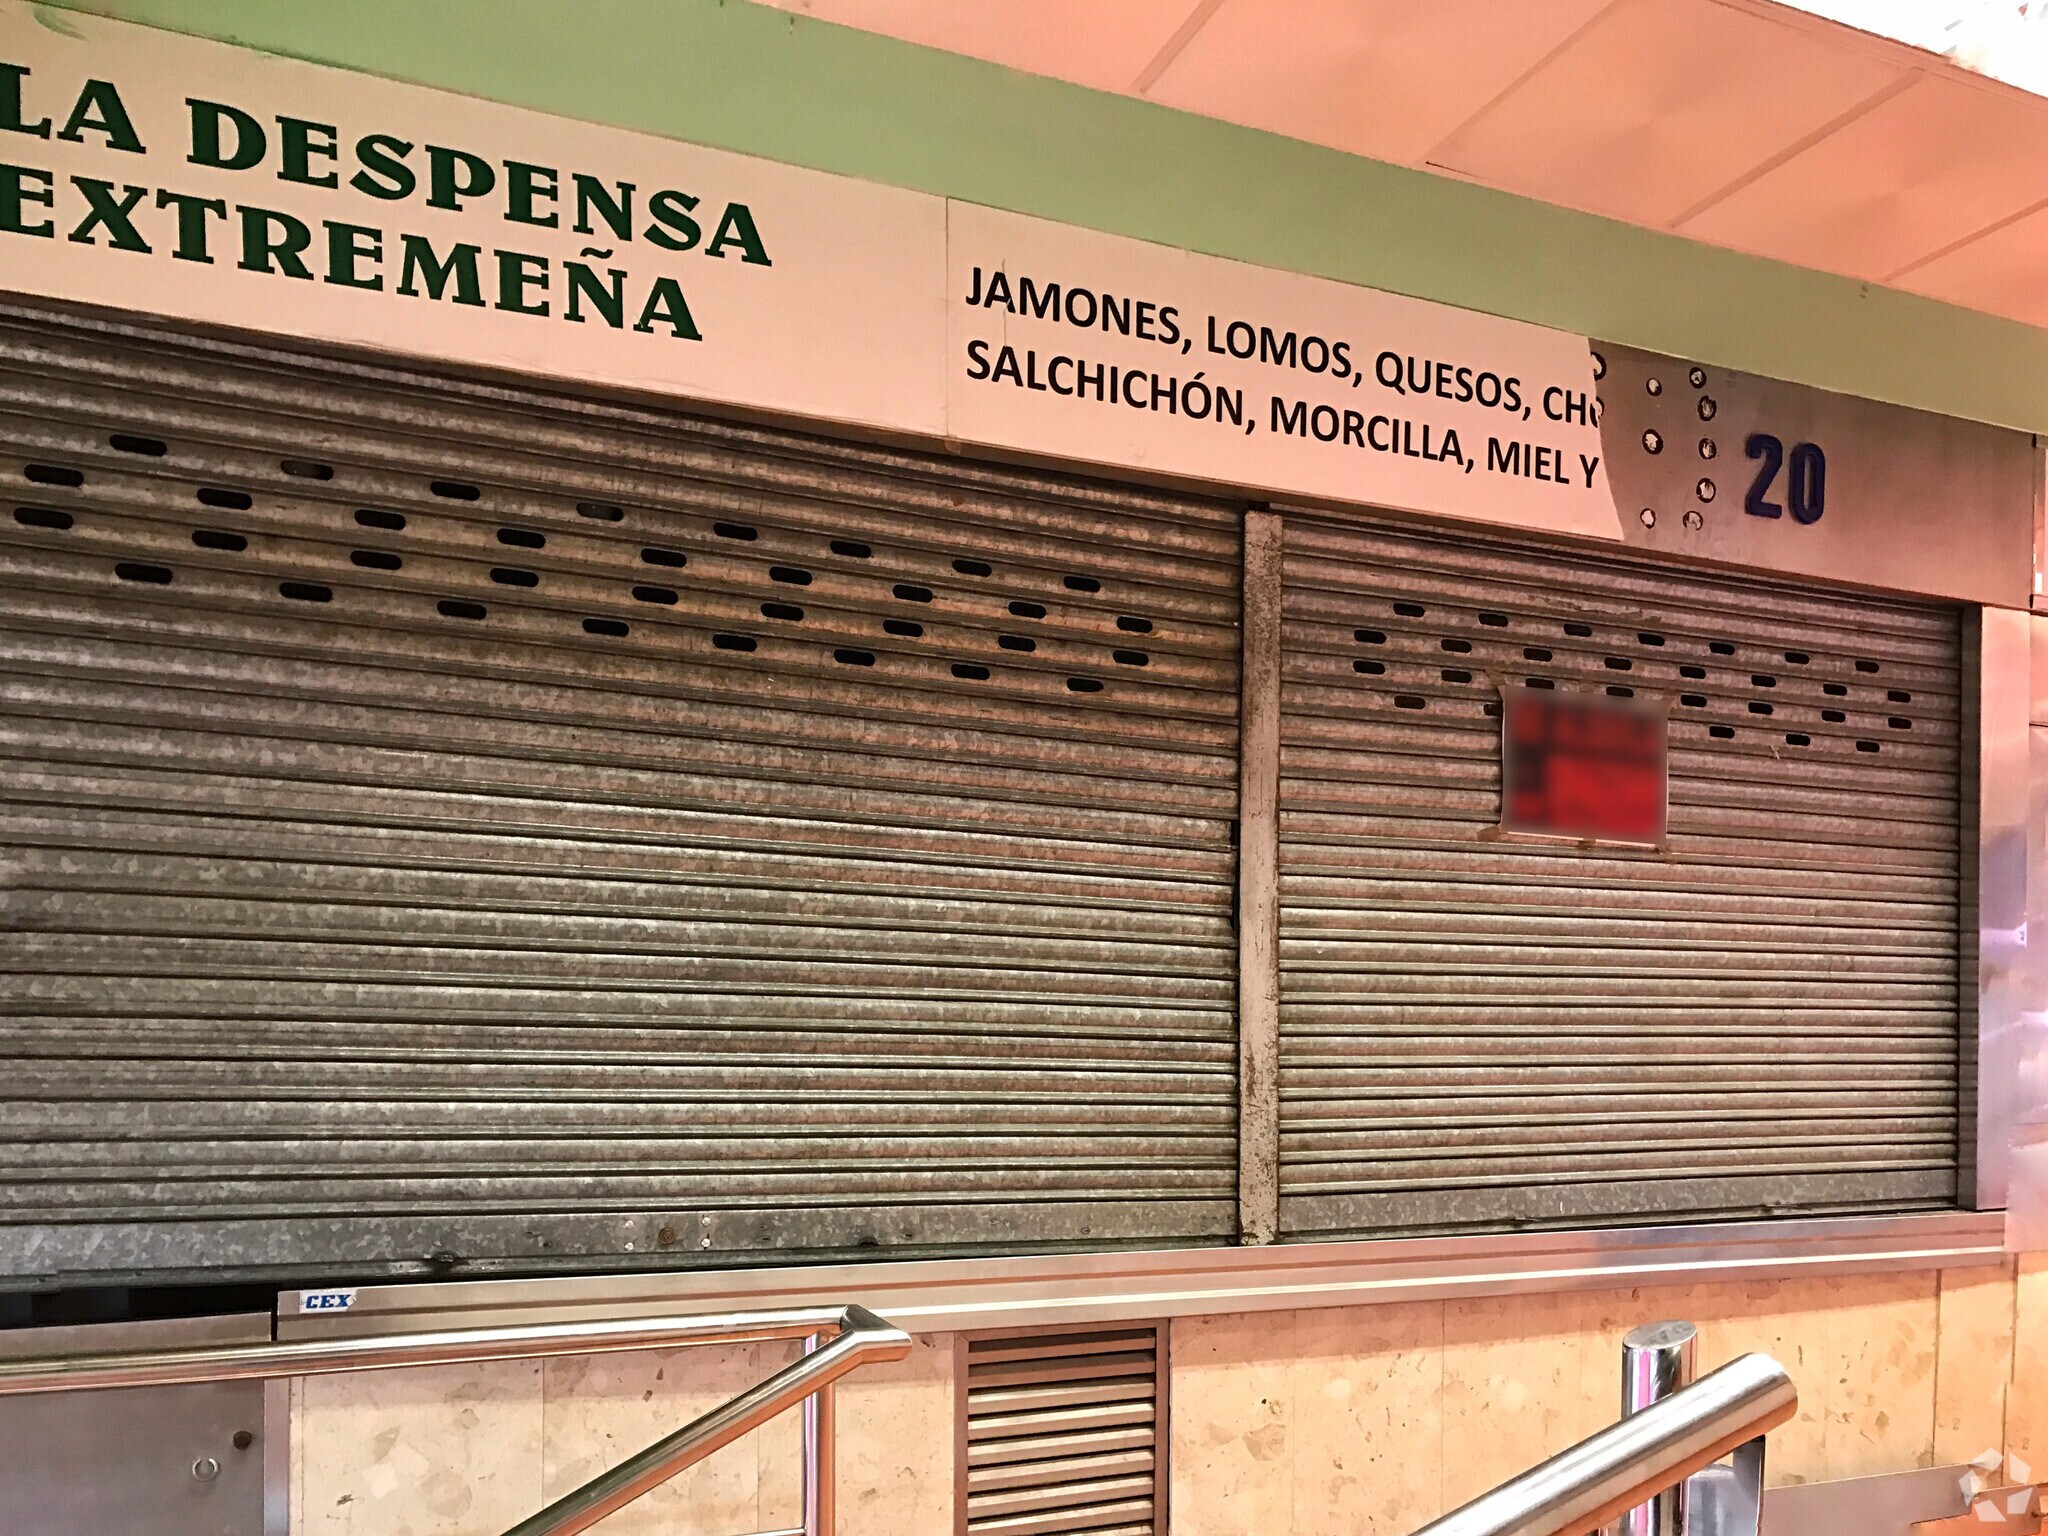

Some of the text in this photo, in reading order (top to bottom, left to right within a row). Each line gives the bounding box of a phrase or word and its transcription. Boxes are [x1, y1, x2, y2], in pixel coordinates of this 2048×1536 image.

[0, 62, 772, 266] LA DESPENSA
[0, 162, 702, 341] EXTREMEÑA
[966, 266, 1192, 355] JAMONES,
[1207, 315, 1362, 389] LOMOS,
[1376, 351, 1531, 421] QUESOS,
[966, 339, 1600, 489] SALCHICHÓN, MORCILLA, MIEL Y
[1744, 433, 1826, 525] 20
[305, 1294, 351, 1309] CEX
